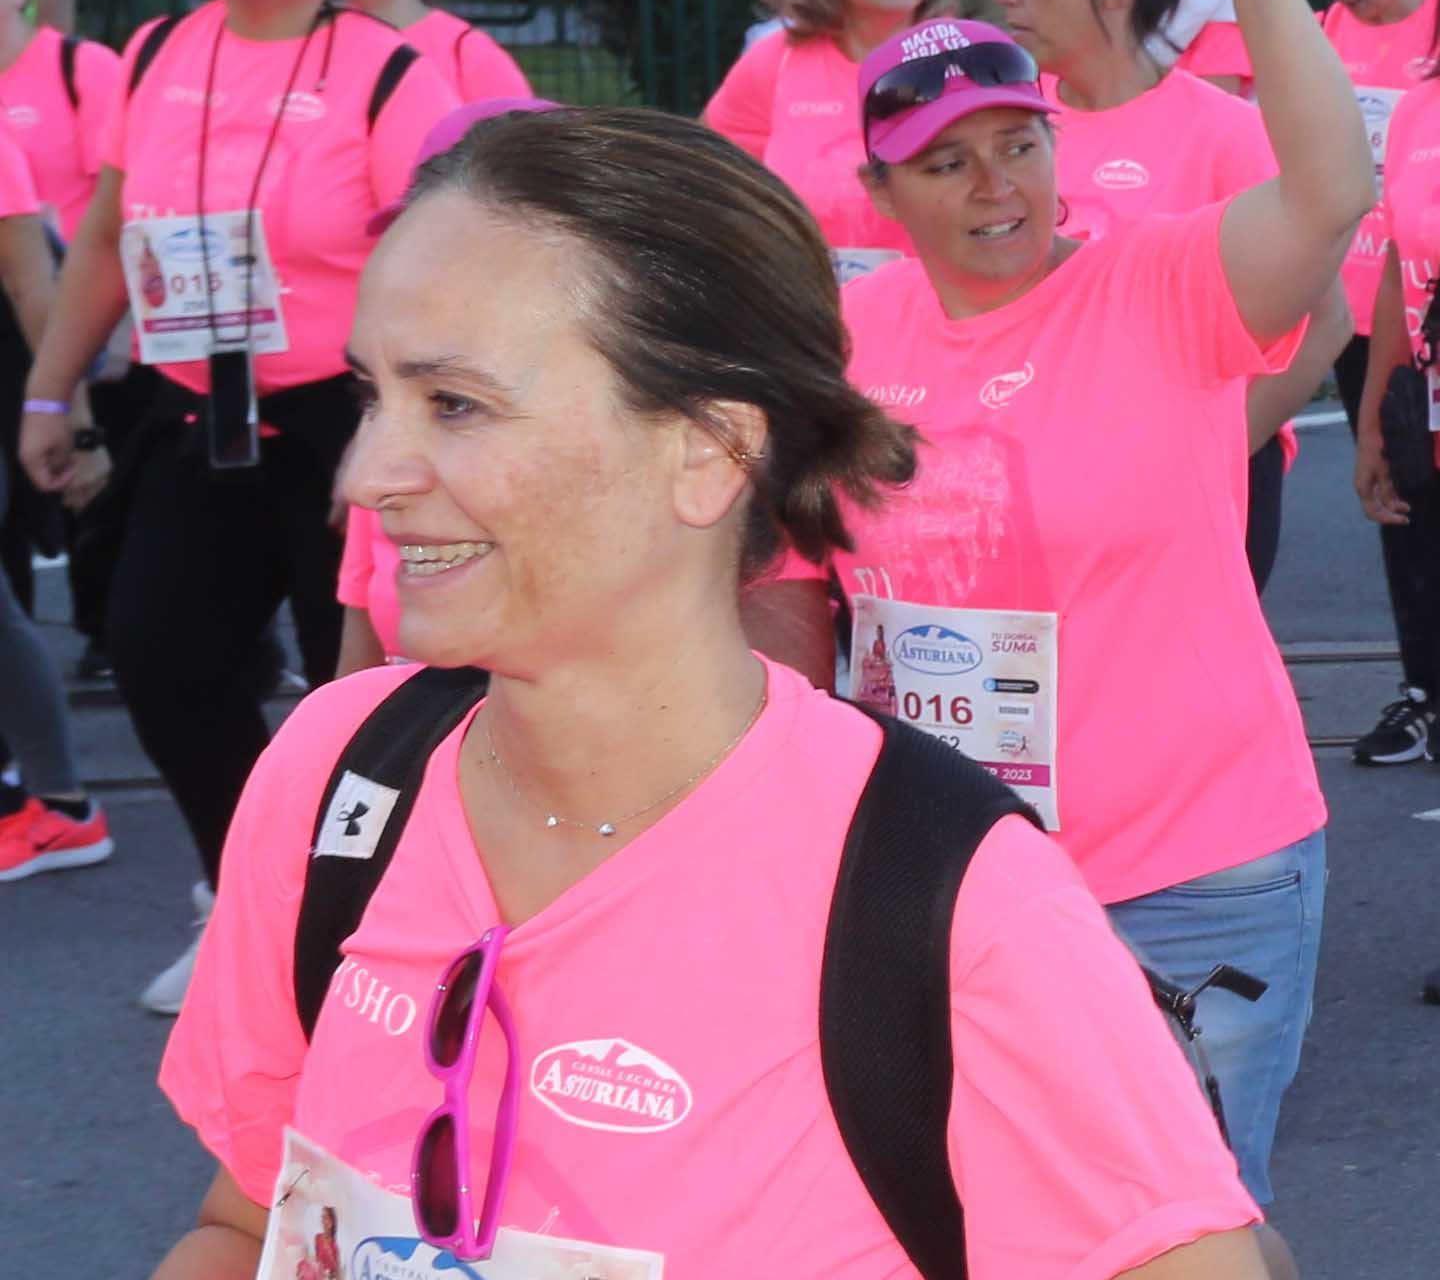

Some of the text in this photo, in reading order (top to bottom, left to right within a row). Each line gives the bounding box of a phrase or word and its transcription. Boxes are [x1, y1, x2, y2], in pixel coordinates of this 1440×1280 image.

[899, 639, 977, 665] ASTURIANA
[991, 639, 1038, 654] SUMA
[902, 690, 975, 725] 016
[1001, 767, 1033, 782] 2023
[333, 961, 417, 1036] YSHO
[536, 1058, 676, 1121] ASTURIANA
